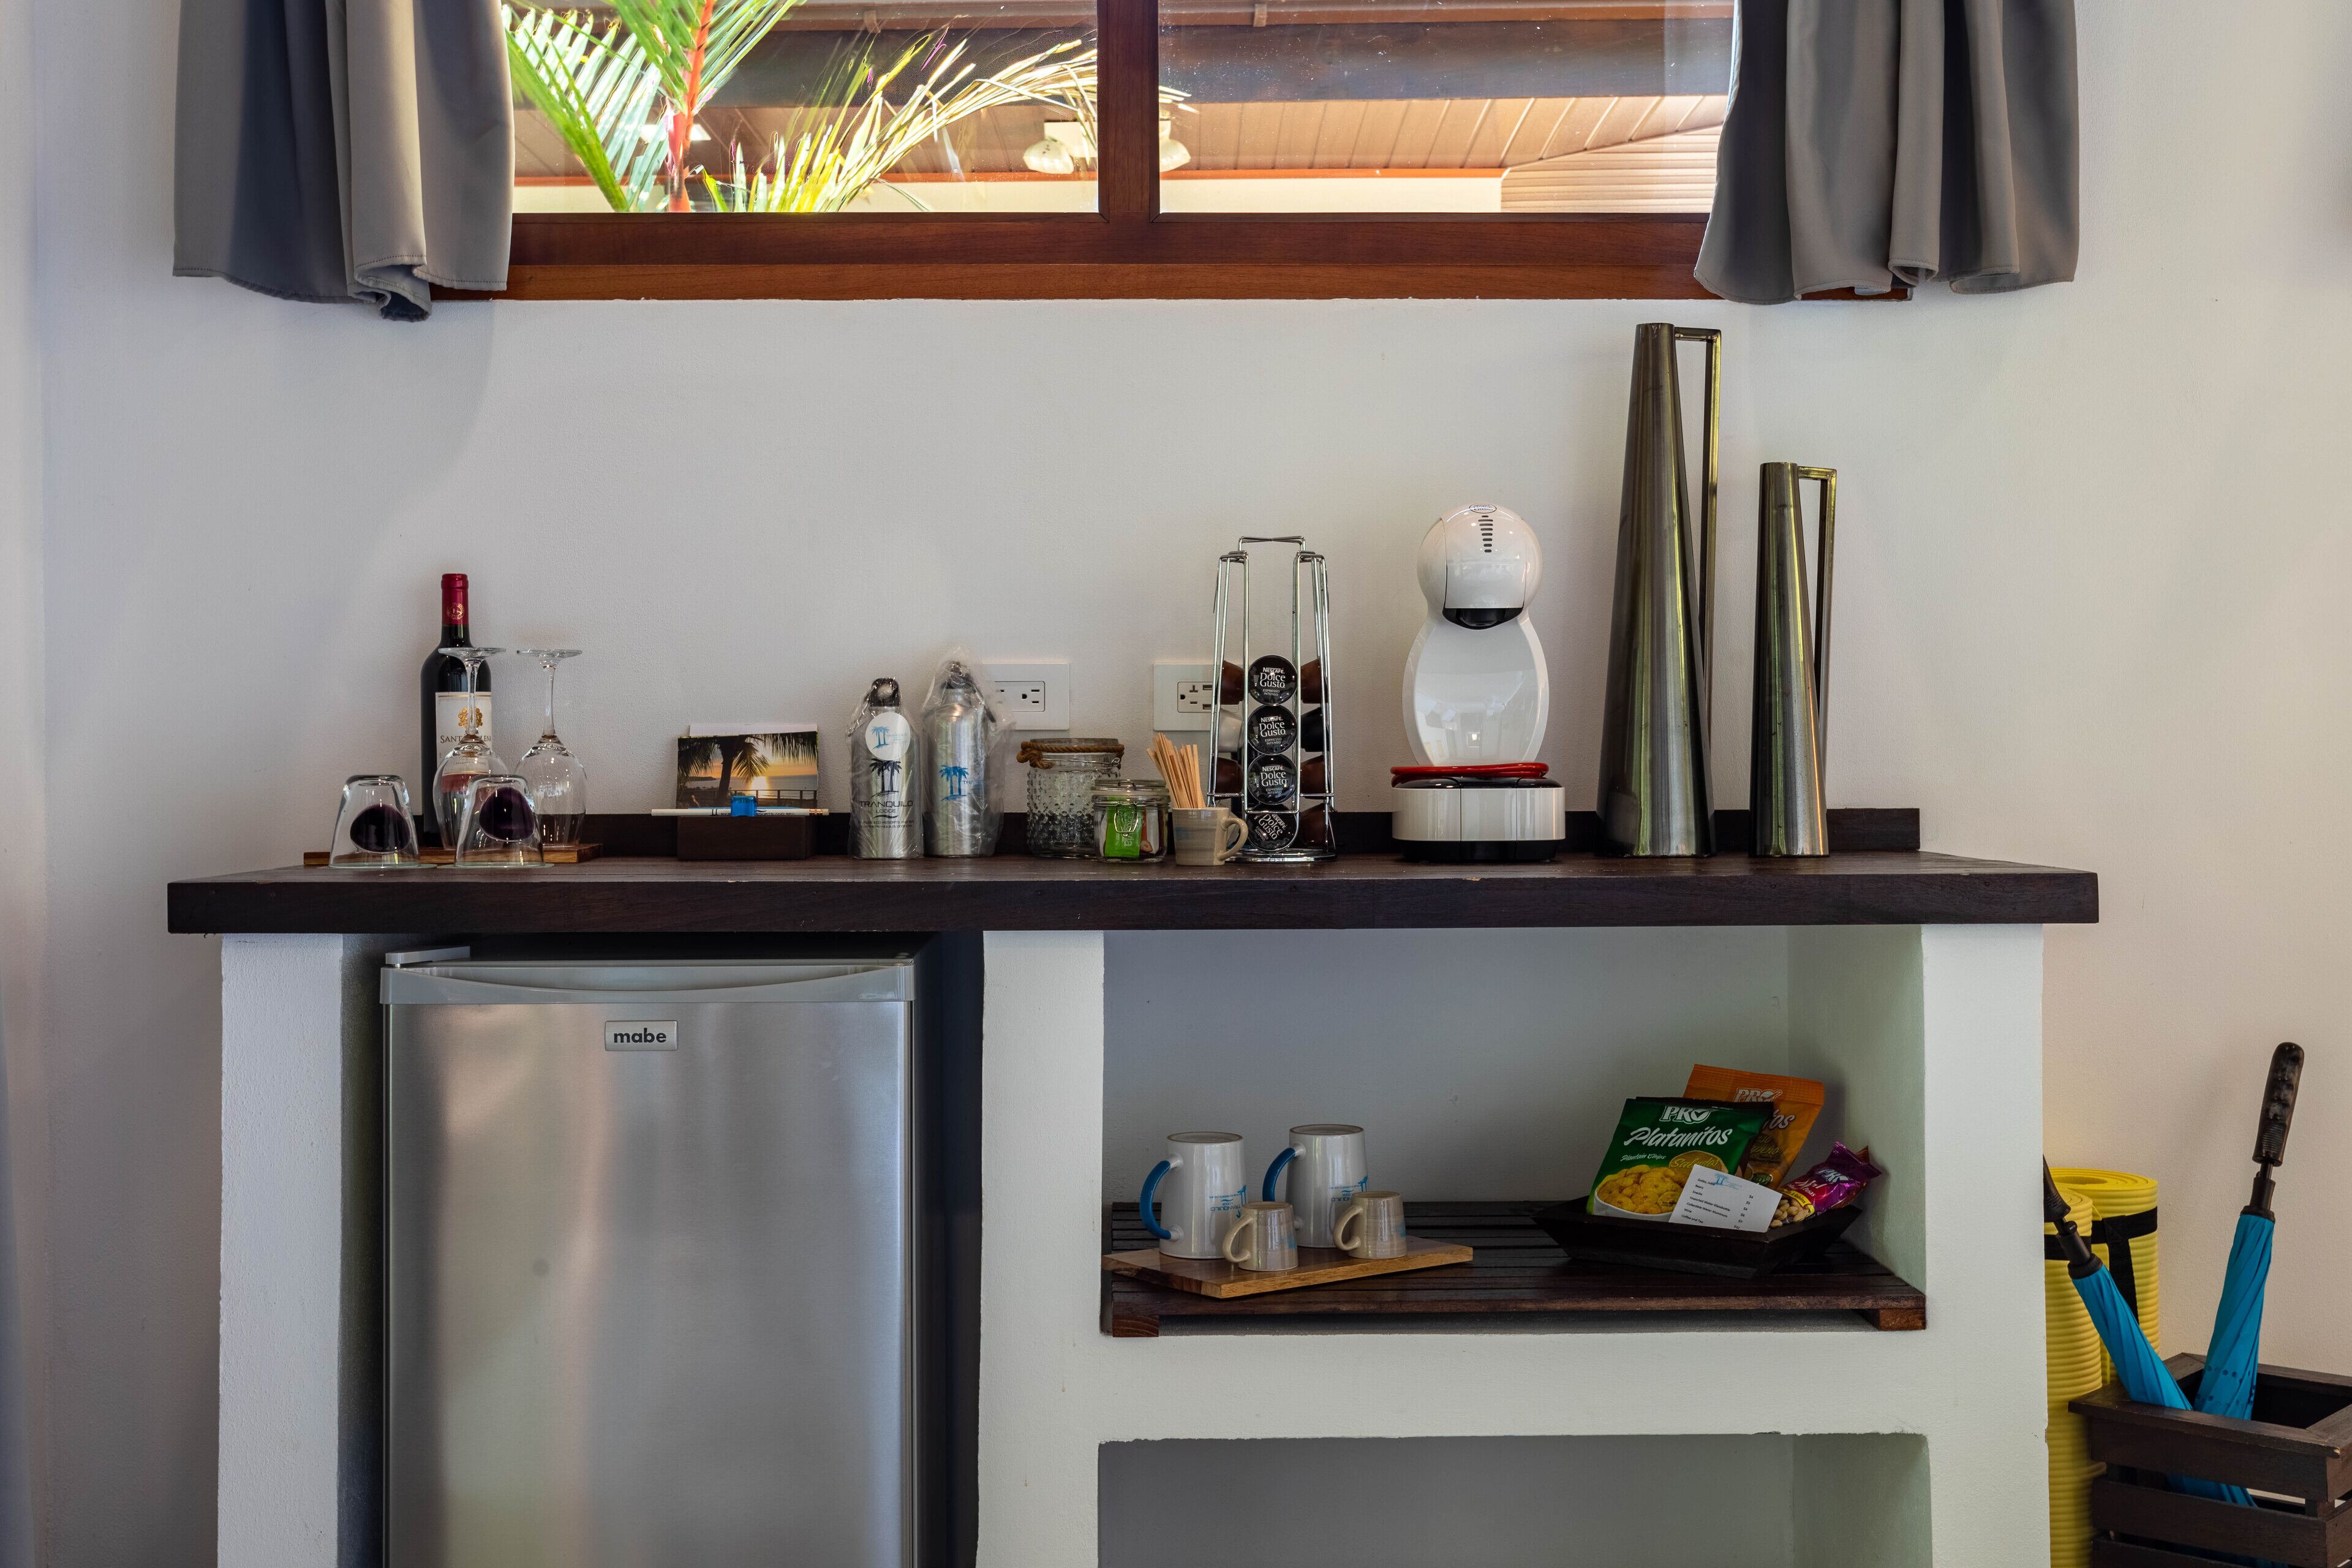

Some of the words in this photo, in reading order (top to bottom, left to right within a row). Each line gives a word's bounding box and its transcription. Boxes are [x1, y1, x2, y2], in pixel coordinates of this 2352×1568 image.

[1260, 673, 1286, 682] Dolce
[1260, 680, 1285, 688] Gusto
[1259, 722, 1285, 731] Dolce
[1260, 729, 1286, 737] Gusto
[1261, 771, 1286, 780] Dolce
[1259, 818, 1278, 839] Gusto
[1262, 813, 1283, 835] Dolce
[614, 1028, 666, 1043] mabe
[1624, 1126, 1733, 1147] Platanitos
